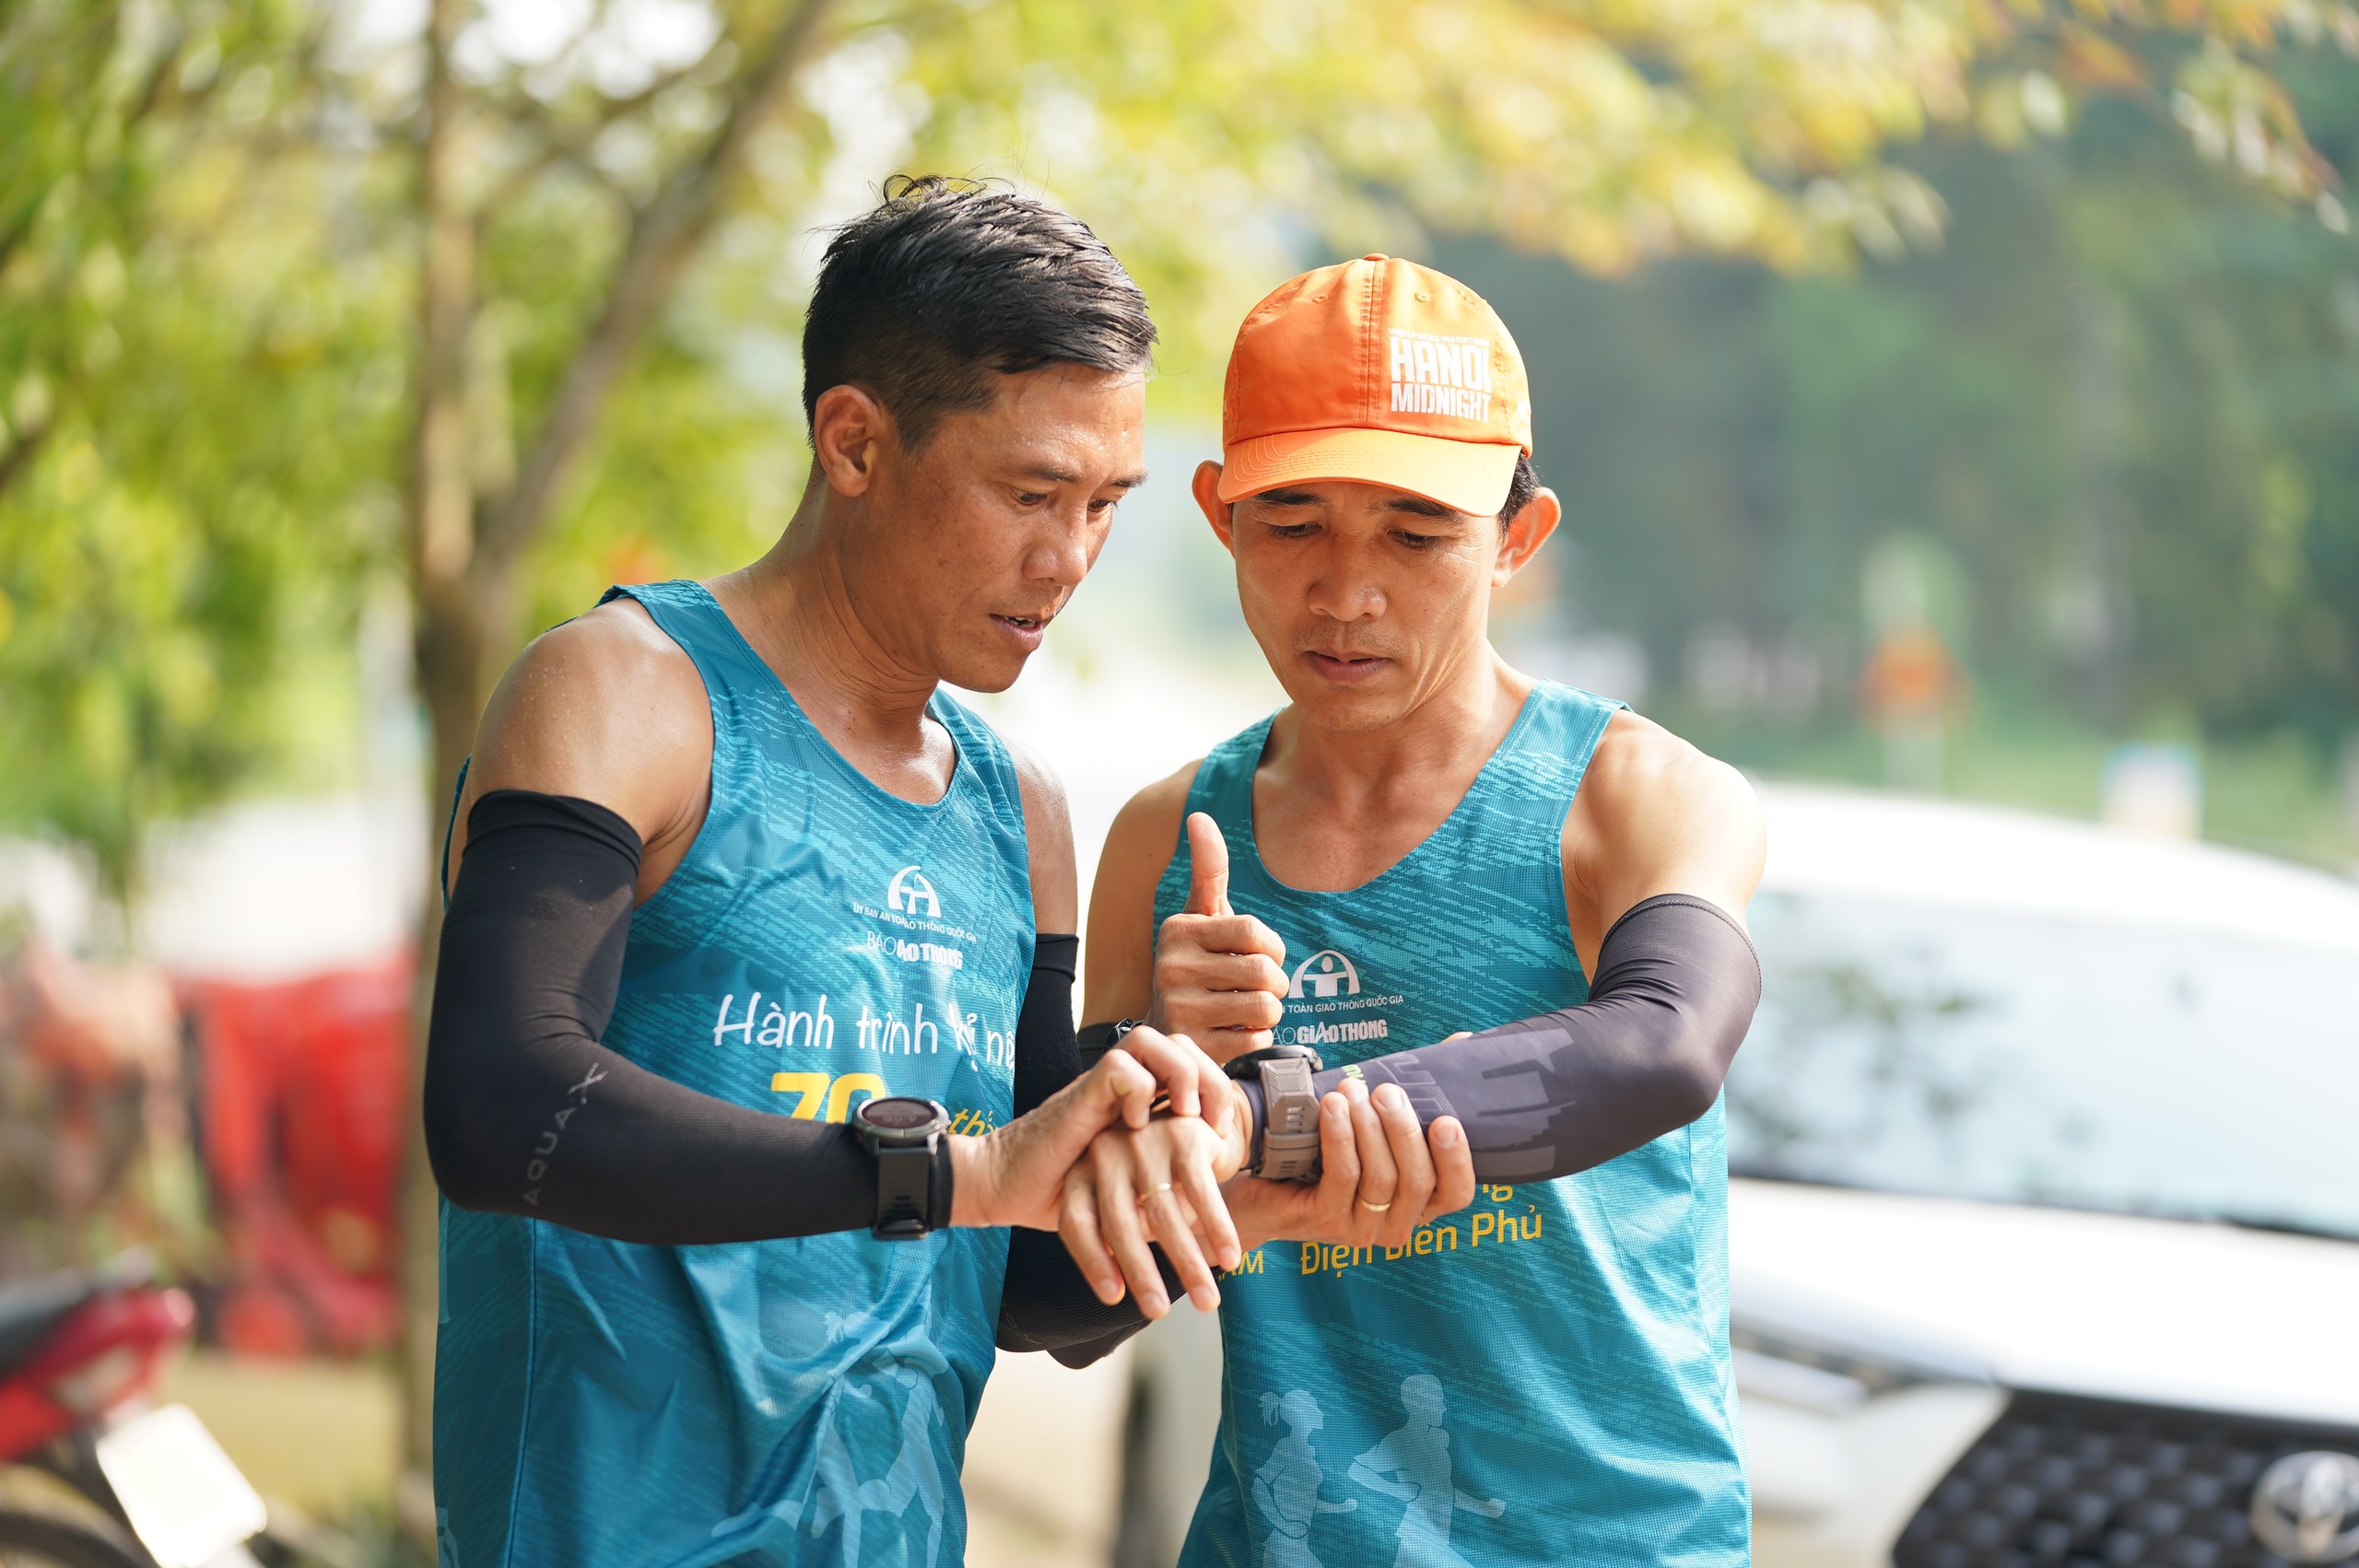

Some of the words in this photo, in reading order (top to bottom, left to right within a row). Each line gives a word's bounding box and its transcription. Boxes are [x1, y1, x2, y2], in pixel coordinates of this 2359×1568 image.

[1390, 336, 1491, 394] HANOI
[1391, 383, 1491, 423] MIDNIGHT
[864, 906, 879, 919] BAN
[879, 911, 890, 922] AN
[713, 991, 834, 1049] Hành
[856, 1002, 938, 1055] trình
[1288, 1003, 1312, 1014] TOÀN
[1315, 1003, 1336, 1012] GIAO
[1337, 999, 1365, 1011] THÔNG
[1367, 993, 1388, 1008] QUỐC
[1389, 995, 1403, 1005] GIA
[1273, 1024, 1297, 1045] ÁO
[1472, 1204, 1543, 1247] Phủ
